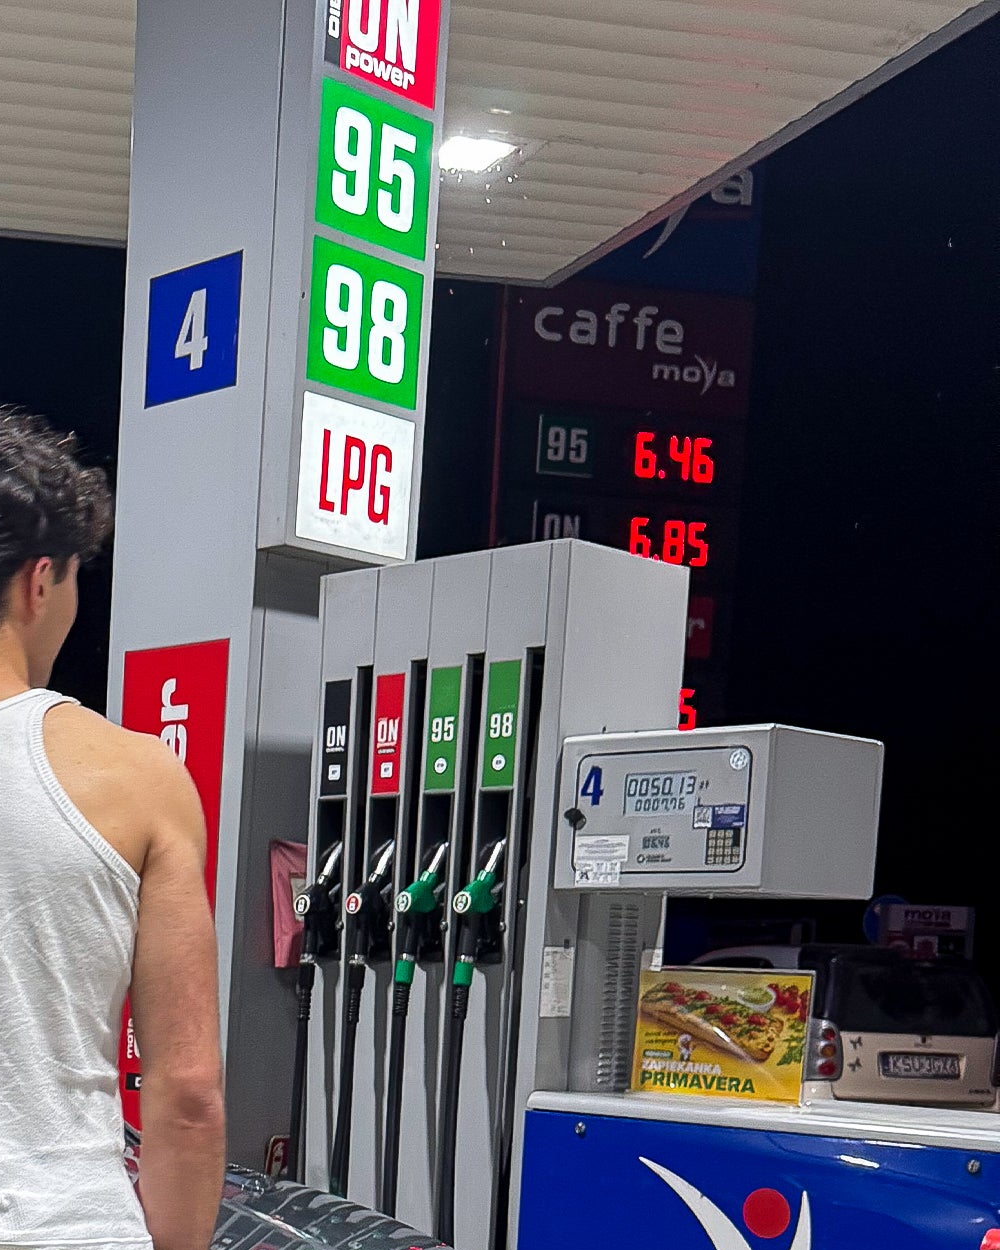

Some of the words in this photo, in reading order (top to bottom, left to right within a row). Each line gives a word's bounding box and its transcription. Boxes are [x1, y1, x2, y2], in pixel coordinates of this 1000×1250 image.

[345, 45, 415, 90] power
[331, 106, 417, 233] 95
[174, 288, 208, 370] 4
[322, 263, 408, 385] 98
[534, 303, 684, 356] caffe
[652, 355, 736, 395] moya
[318, 428, 392, 525] LPG
[547, 427, 588, 465] 95
[634, 432, 714, 484] 6.46
[629, 517, 709, 567] 6.85
[326, 725, 347, 747] ON
[377, 718, 400, 744] ON
[431, 716, 455, 743] 95
[489, 712, 514, 738] 98
[580, 765, 604, 806] 4
[640, 1071, 756, 1094] PRIMAVERA
[641, 1060, 722, 1075] ZAPIEKANKA
